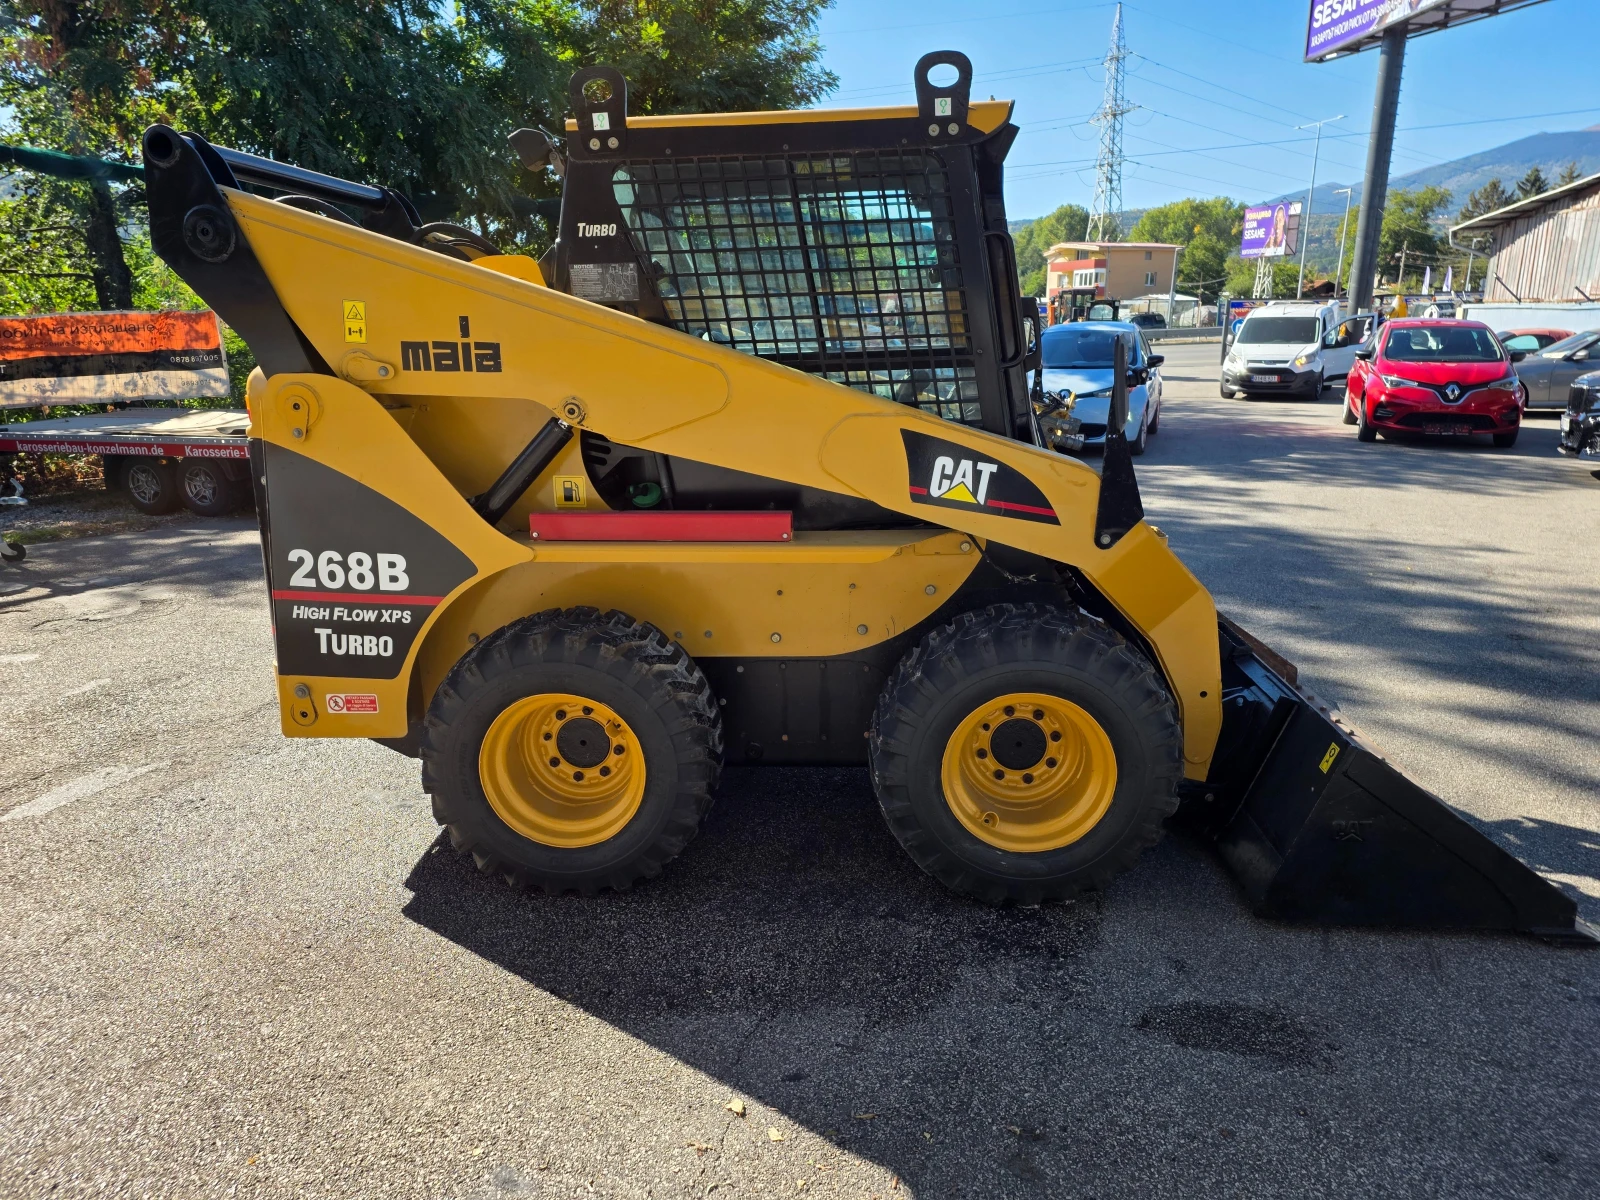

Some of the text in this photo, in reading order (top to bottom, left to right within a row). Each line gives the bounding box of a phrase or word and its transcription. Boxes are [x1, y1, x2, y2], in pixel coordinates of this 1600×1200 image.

[1313, 0, 1375, 28] SESA
[0, 323, 156, 339] обил на изплащане
[16, 440, 164, 456] karosseriebau-konzelmann.de
[929, 455, 999, 506] CAT
[287, 548, 410, 591] 268B
[380, 609, 412, 624] XPS
